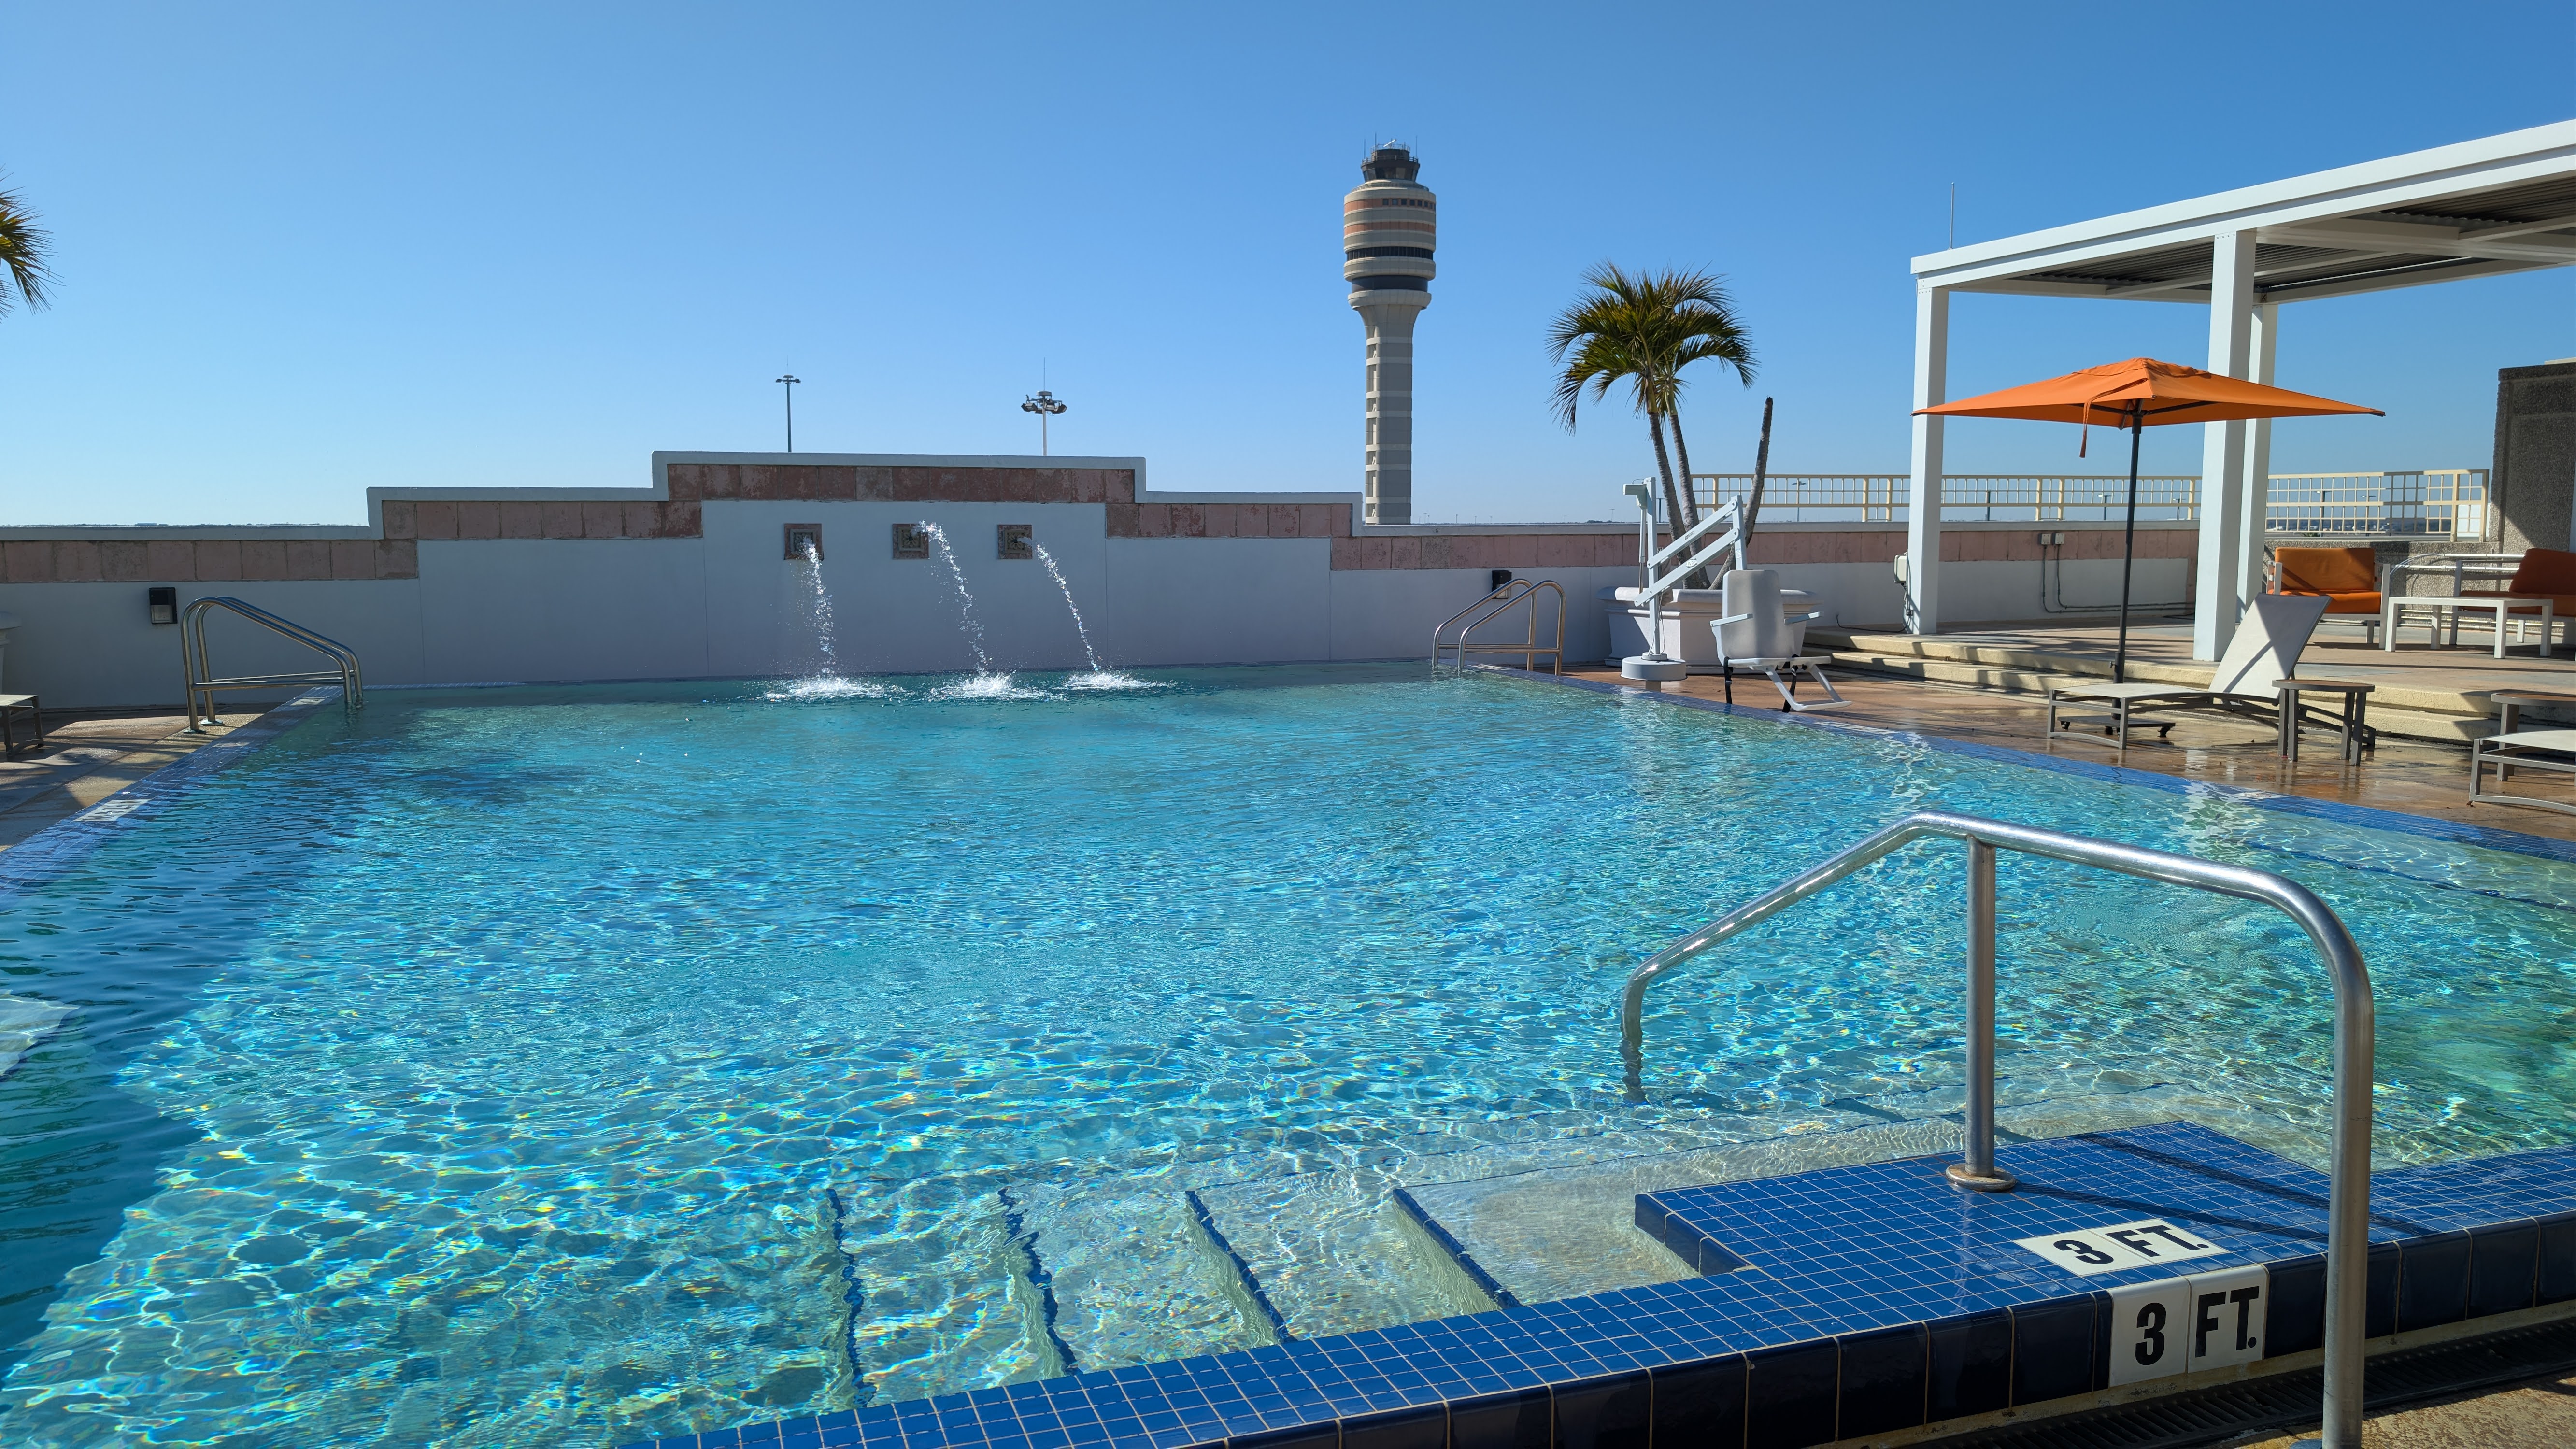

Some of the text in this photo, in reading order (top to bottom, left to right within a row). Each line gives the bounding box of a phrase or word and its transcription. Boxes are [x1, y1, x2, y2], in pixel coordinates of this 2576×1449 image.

[2053, 1225, 2209, 1264] 3 FT.
[2135, 1286, 2260, 1366] 3 FT.
